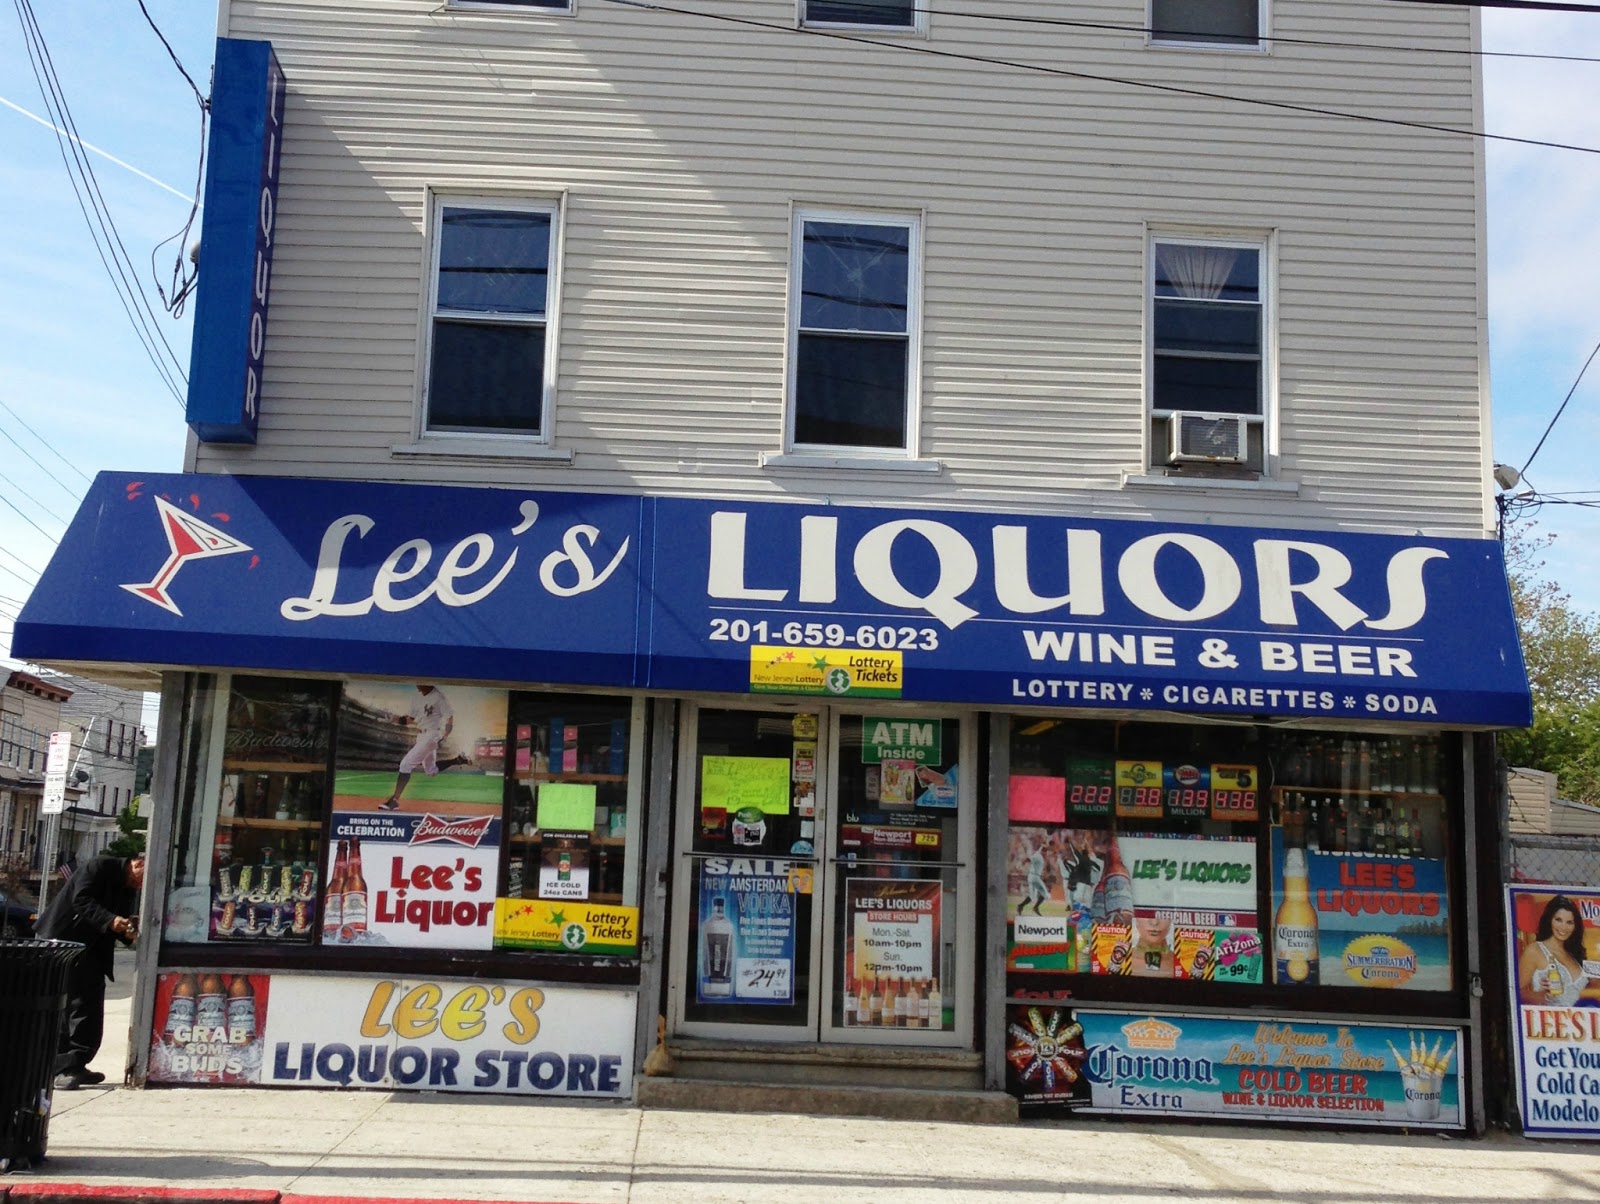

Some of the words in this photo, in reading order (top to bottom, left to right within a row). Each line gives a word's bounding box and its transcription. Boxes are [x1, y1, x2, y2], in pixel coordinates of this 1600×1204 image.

[245, 72, 278, 420] LIQUOR
[280, 499, 631, 621] Lee's
[707, 511, 1450, 631] LIQUORS
[708, 618, 940, 651] 201-659-6023
[1022, 630, 1176, 666] WINE
[1198, 638, 1237, 669] &
[1260, 641, 1418, 677] BEER
[849, 656, 895, 671] Lottery
[795, 676, 825, 685] Lottery
[856, 669, 899, 683] Tickets
[1012, 679, 1133, 702] LOTTERY
[1163, 686, 1335, 711] CIGARETTES
[1365, 694, 1438, 715] SODA
[871, 722, 934, 747] ATM
[877, 746, 926, 760] Inside
[1073, 804, 1109, 812] MILLION
[1171, 808, 1206, 816] MILLION
[349, 817, 369, 825] BRING
[381, 818, 394, 826] THE
[411, 819, 489, 838] Budweiser
[337, 825, 405, 838] CELEBRATION
[873, 829, 912, 838] Newport
[391, 856, 482, 891] Lee's
[705, 858, 790, 876] SALE
[1132, 859, 1178, 881] LEE'S
[1180, 861, 1252, 885] LIQUORS
[1339, 860, 1416, 889] LEE'S
[705, 877, 727, 891] NEW
[375, 889, 494, 933] Liquor
[737, 893, 791, 914] VODKA
[855, 898, 884, 909] LEE'S
[886, 899, 933, 910] LIQUORS
[1316, 887, 1440, 917] LIQUORS
[585, 911, 631, 928] Lottery
[869, 912, 892, 920] STORE
[893, 913, 917, 921] HOURS
[1194, 910, 1216, 926] BEER
[532, 930, 560, 939] Lottery
[591, 925, 633, 940] Tickets
[1018, 924, 1065, 936] Newport
[1096, 926, 1127, 935] CAUTION
[1179, 931, 1210, 940] CAUTION
[1278, 926, 1315, 940] Corona
[864, 939, 922, 949] 10am-10pm
[1216, 935, 1262, 958] AriZona
[883, 952, 903, 961] Sun.
[864, 963, 923, 973] 12pm-10pm
[1361, 967, 1400, 979] Corona
[359, 981, 546, 1045] LEE'S
[173, 1023, 247, 1044] GRAB
[1525, 1008, 1587, 1041] LEE'S
[1253, 1022, 1328, 1048] Welcome
[1335, 1026, 1354, 1049] To
[185, 1043, 232, 1055] SOME
[1222, 1042, 1269, 1067] Lee's
[1276, 1047, 1332, 1072] Liquor
[1338, 1049, 1385, 1072] Store
[1535, 1045, 1566, 1069] Get
[171, 1055, 243, 1074] BUDS
[273, 1042, 462, 1088] LIQUOR
[473, 1049, 622, 1092] STORE
[1081, 1044, 1214, 1088] Corona
[1238, 1069, 1302, 1093] COLD
[1307, 1072, 1368, 1096] BEER
[1536, 1070, 1576, 1096] Cold
[1119, 1085, 1183, 1108] Extra
[1222, 1091, 1254, 1106] WINE
[1268, 1094, 1315, 1109] LIQUOR
[1317, 1096, 1385, 1112] SELECTION
[1405, 1087, 1441, 1101] Corona
[1531, 1098, 1599, 1123] Modelo
